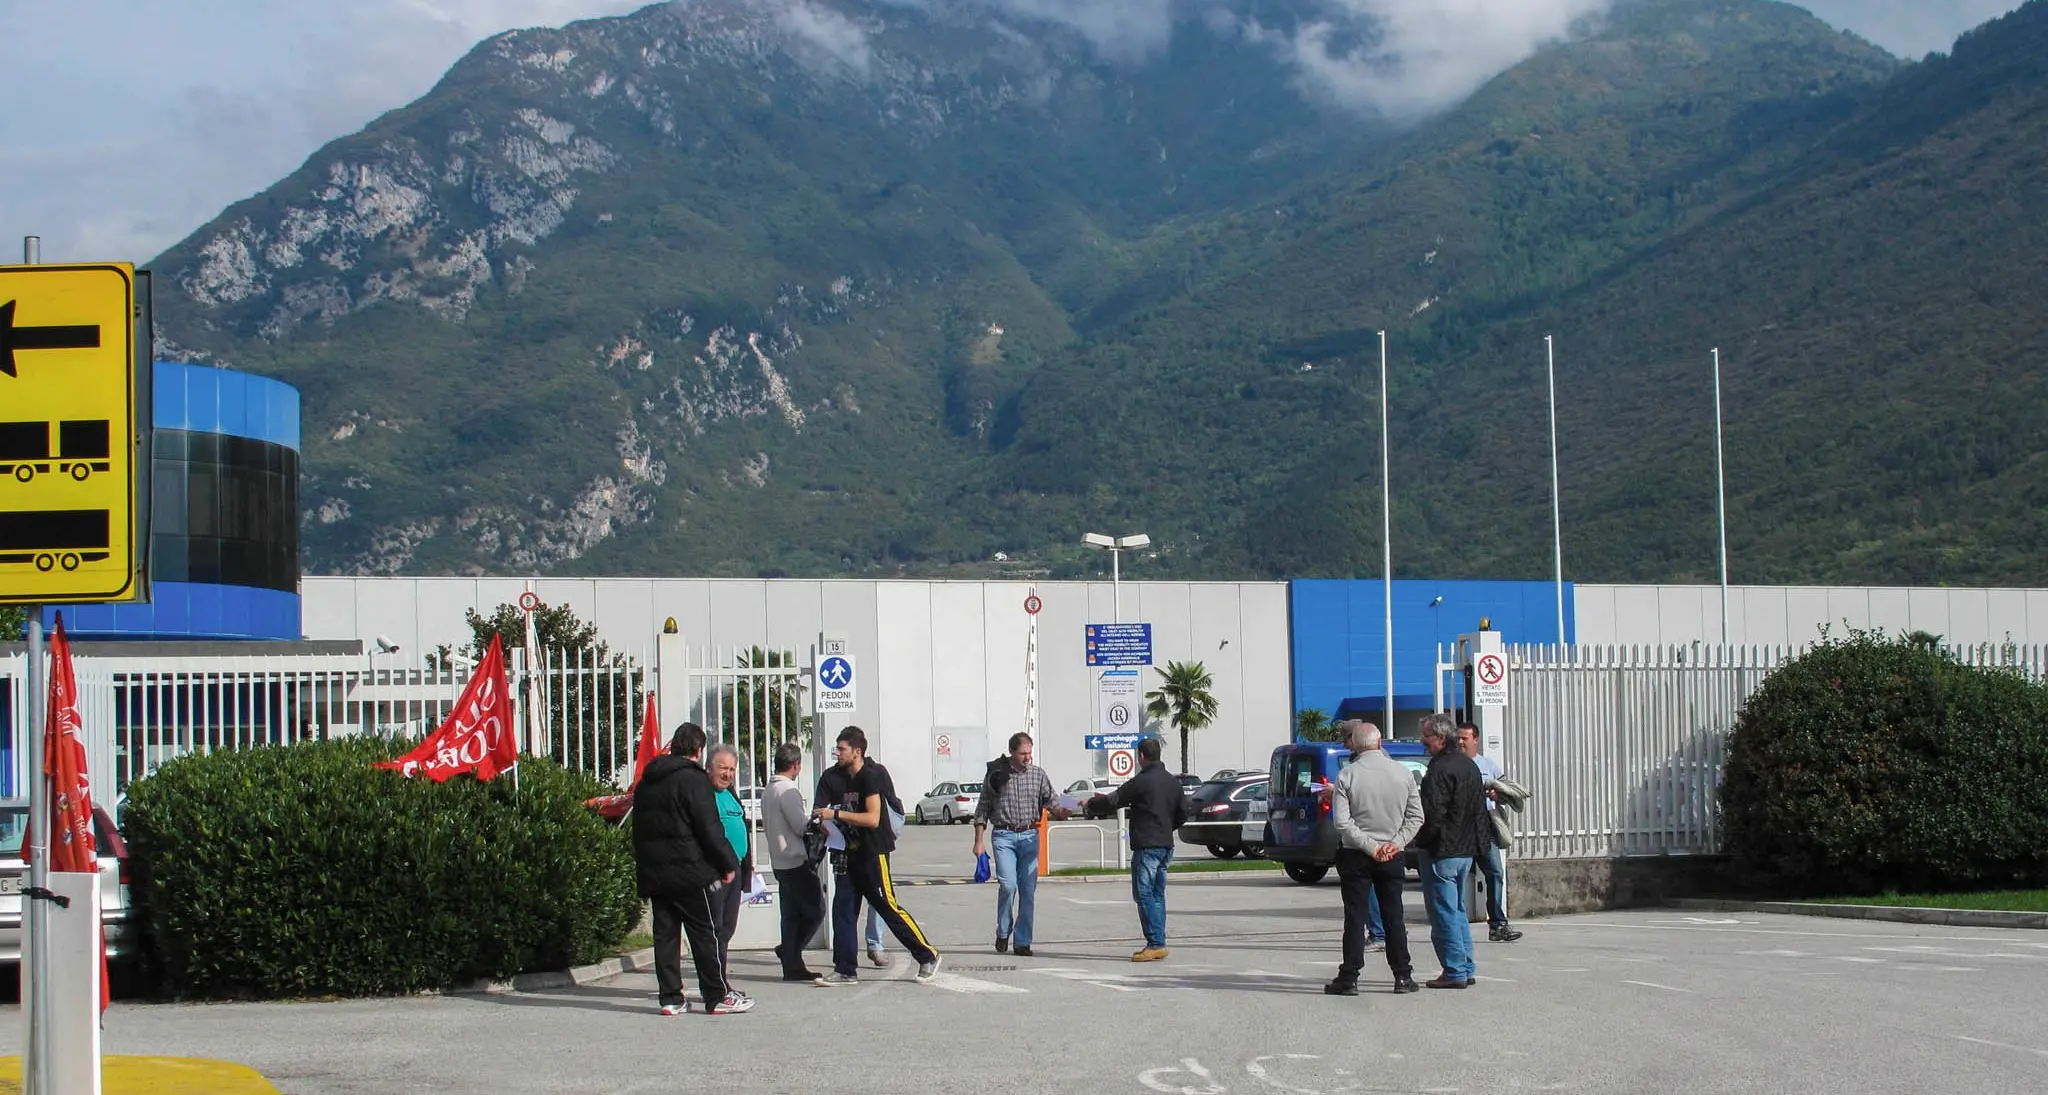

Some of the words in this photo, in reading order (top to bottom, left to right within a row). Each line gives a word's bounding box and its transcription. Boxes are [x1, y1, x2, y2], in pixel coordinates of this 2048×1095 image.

[831, 643, 840, 651] 15
[821, 691, 851, 699] PEDONI
[1103, 735, 1138, 743] parcheggio
[1116, 756, 1128, 770] 15
